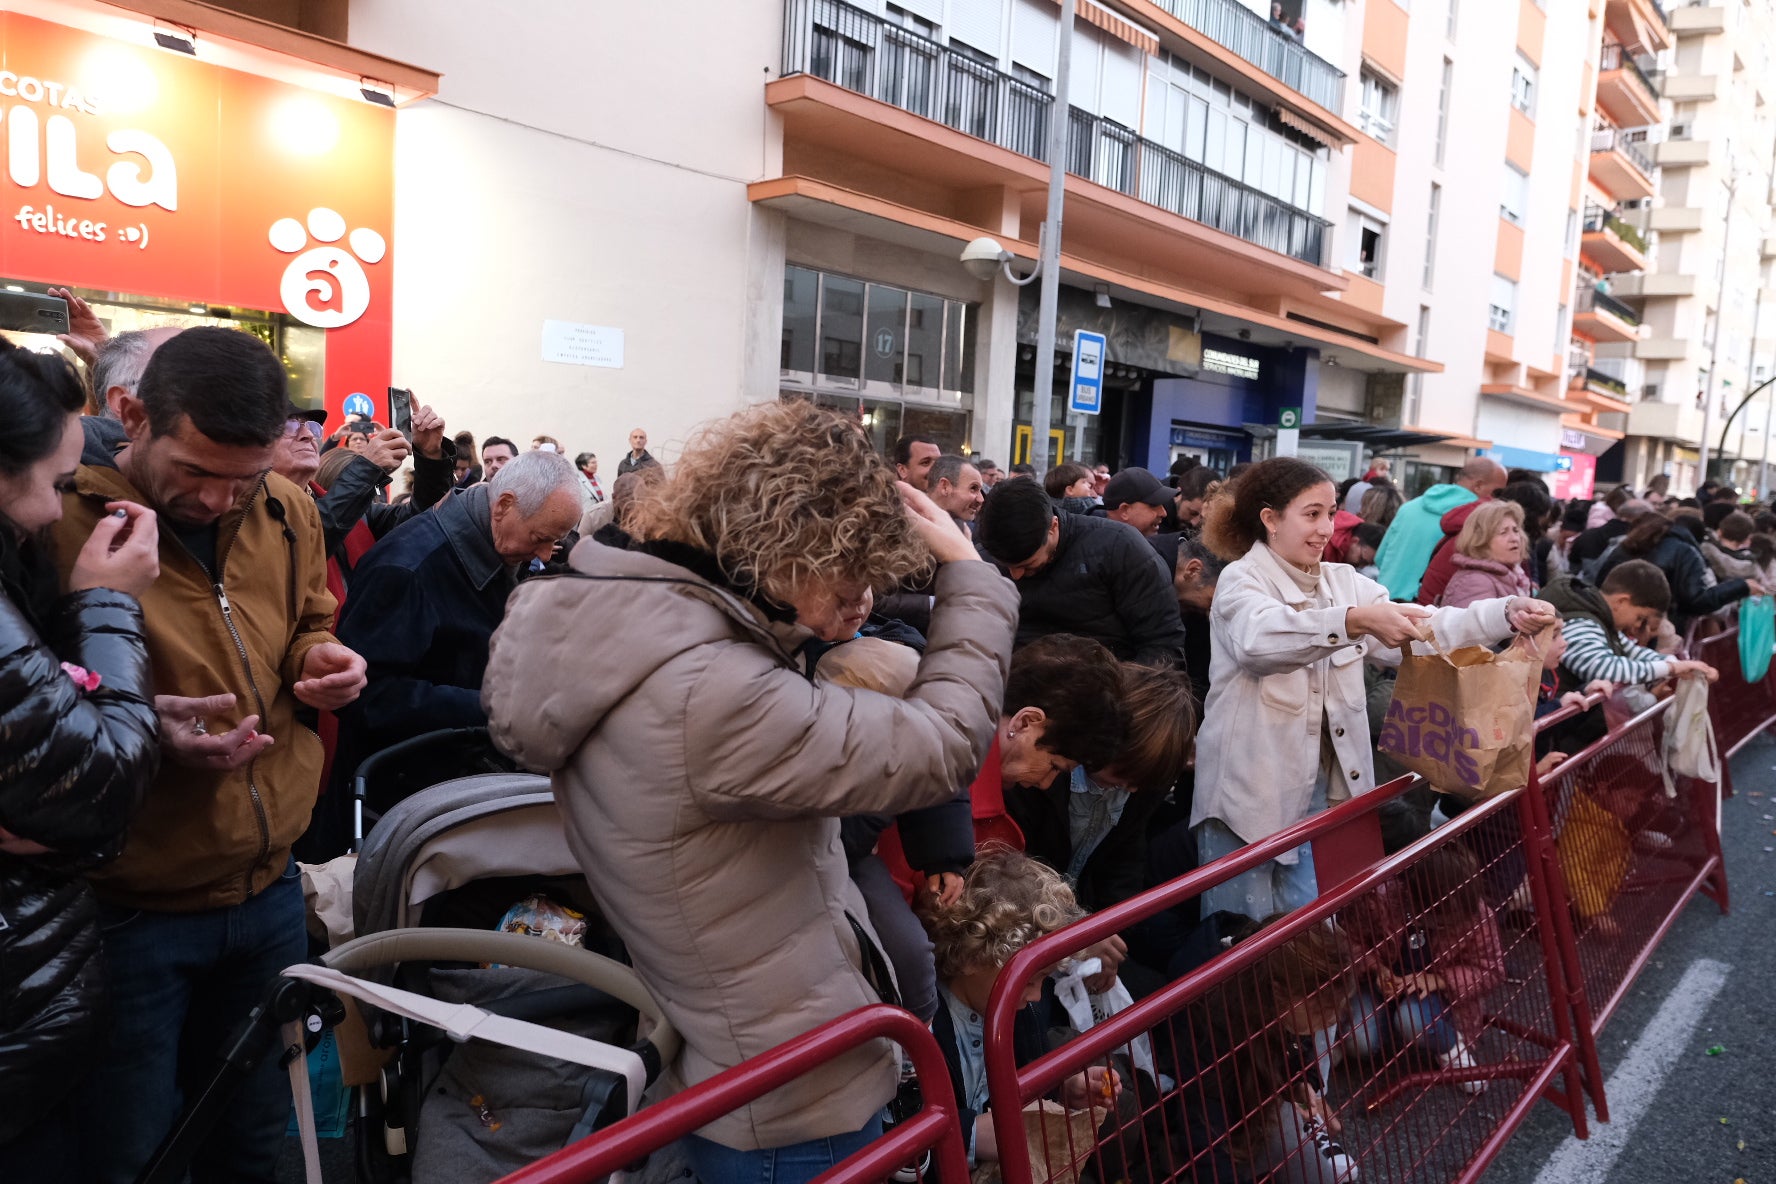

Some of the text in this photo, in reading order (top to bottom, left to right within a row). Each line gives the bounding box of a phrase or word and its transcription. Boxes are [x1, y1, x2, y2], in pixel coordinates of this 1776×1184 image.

[15, 204, 107, 241] felices
[877, 333, 893, 354] 17
[320, 1029, 333, 1062] arom
